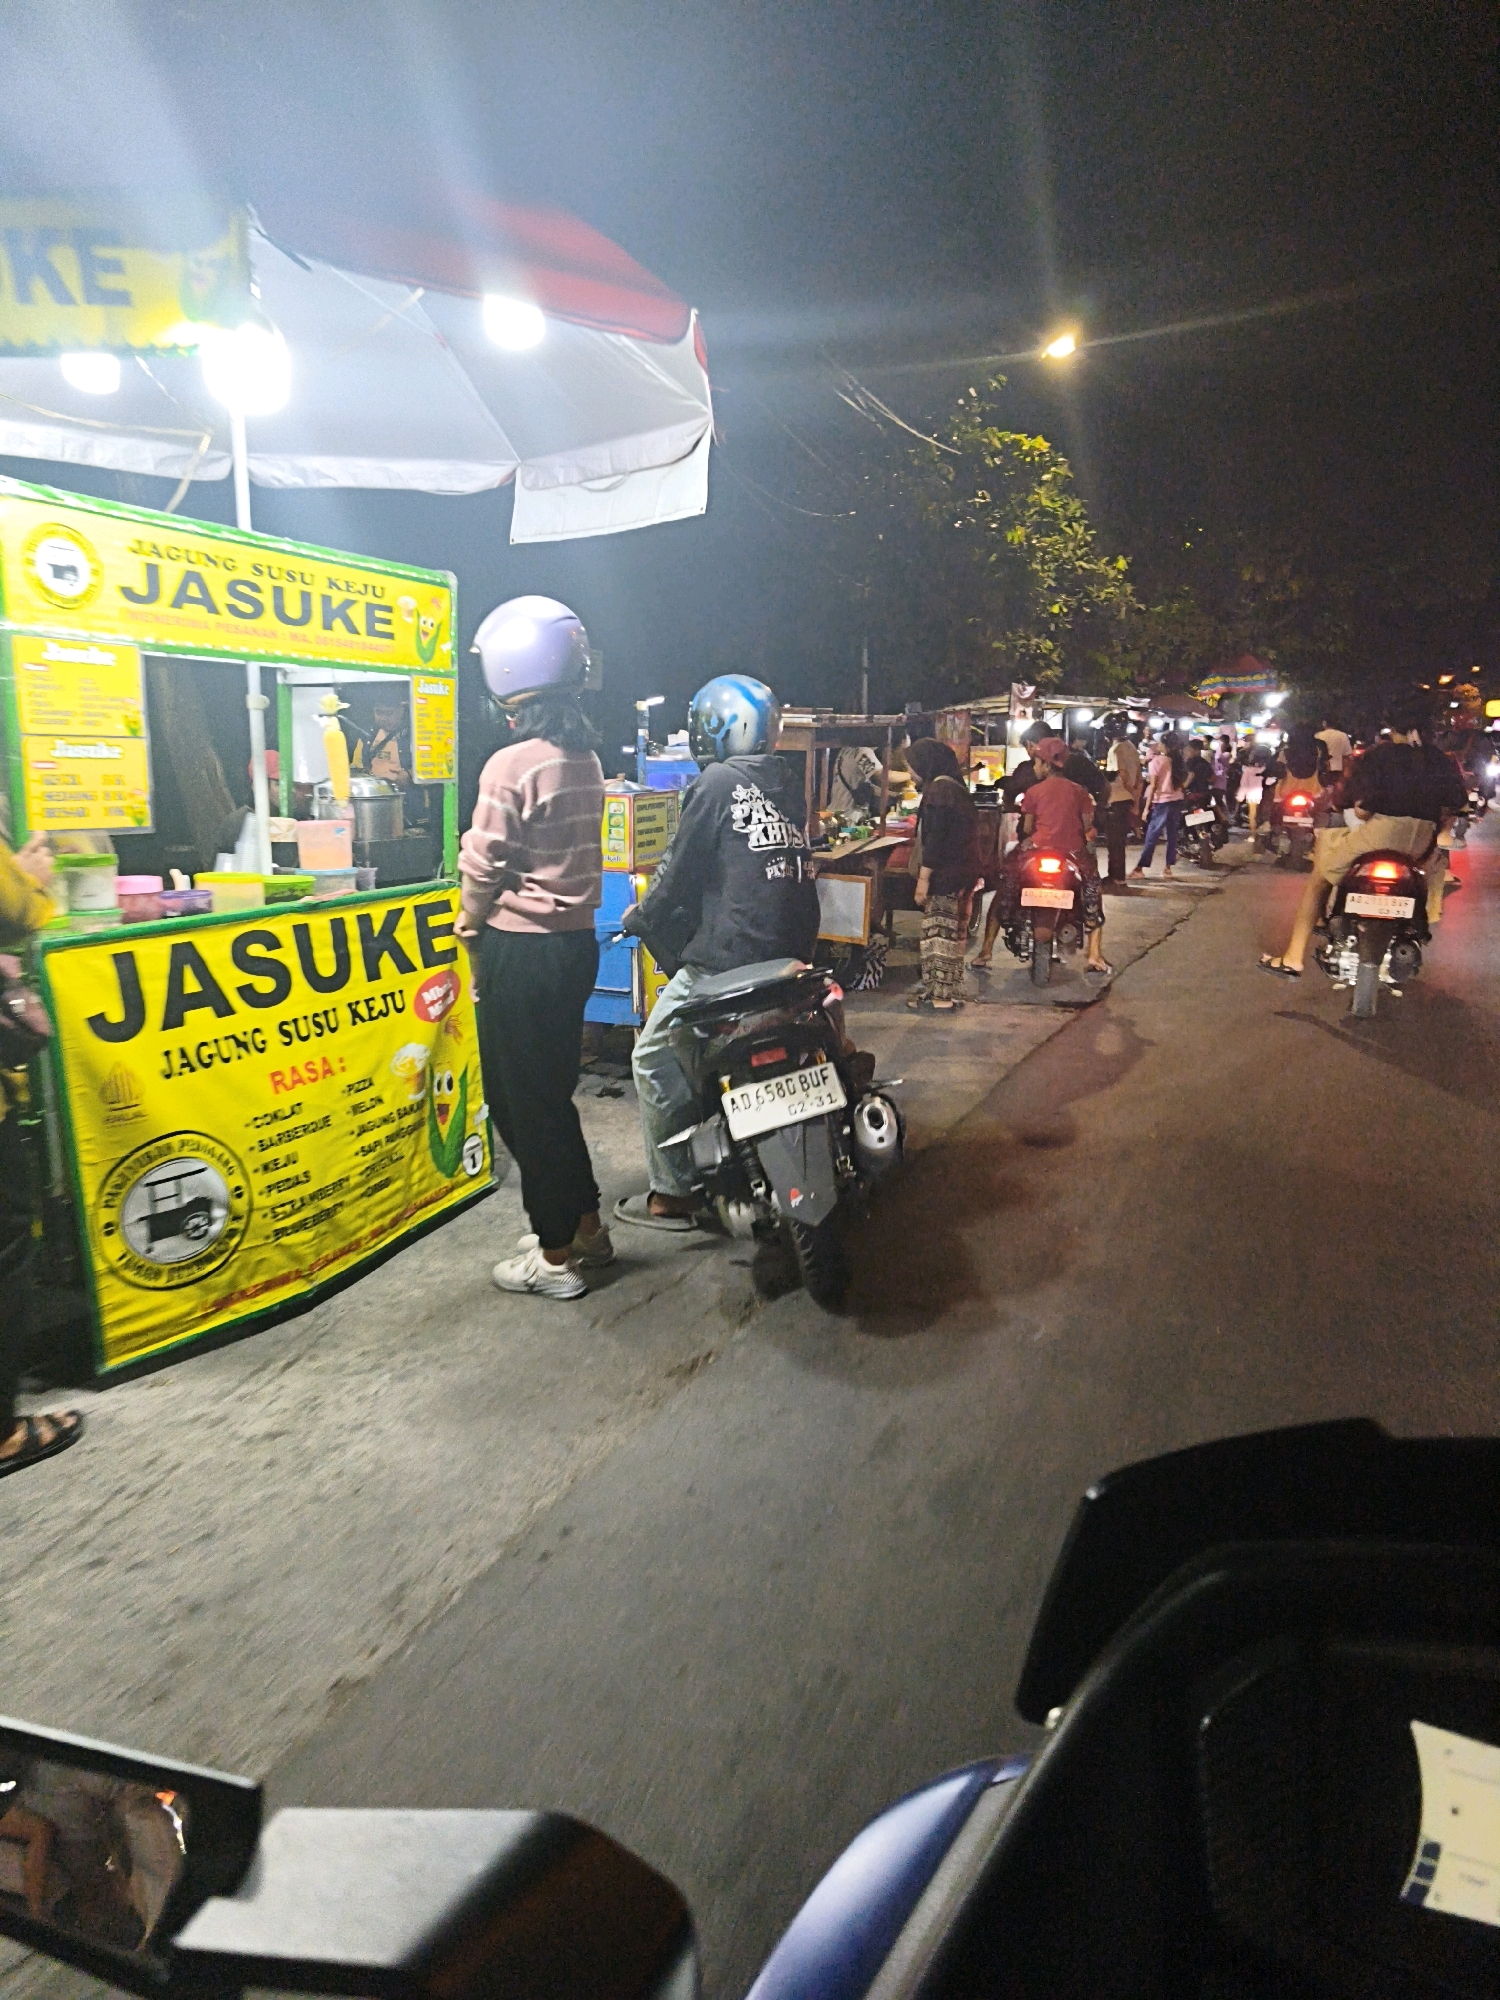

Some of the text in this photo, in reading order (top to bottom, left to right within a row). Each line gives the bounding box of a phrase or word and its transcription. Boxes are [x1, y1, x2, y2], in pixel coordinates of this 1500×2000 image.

[0, 225, 134, 307] KE
[119, 563, 395, 640] JASUKE
[129, 539, 386, 599] JAGUNG SUSU KEJU
[88, 899, 459, 1043] JASUKE
[162, 990, 406, 1080] JAGUNG SUSU KEJU
[269, 1056, 335, 1096] RASA
[730, 1066, 830, 1115] AD 6580 BUF
[260, 1151, 298, 1176] KEJU
